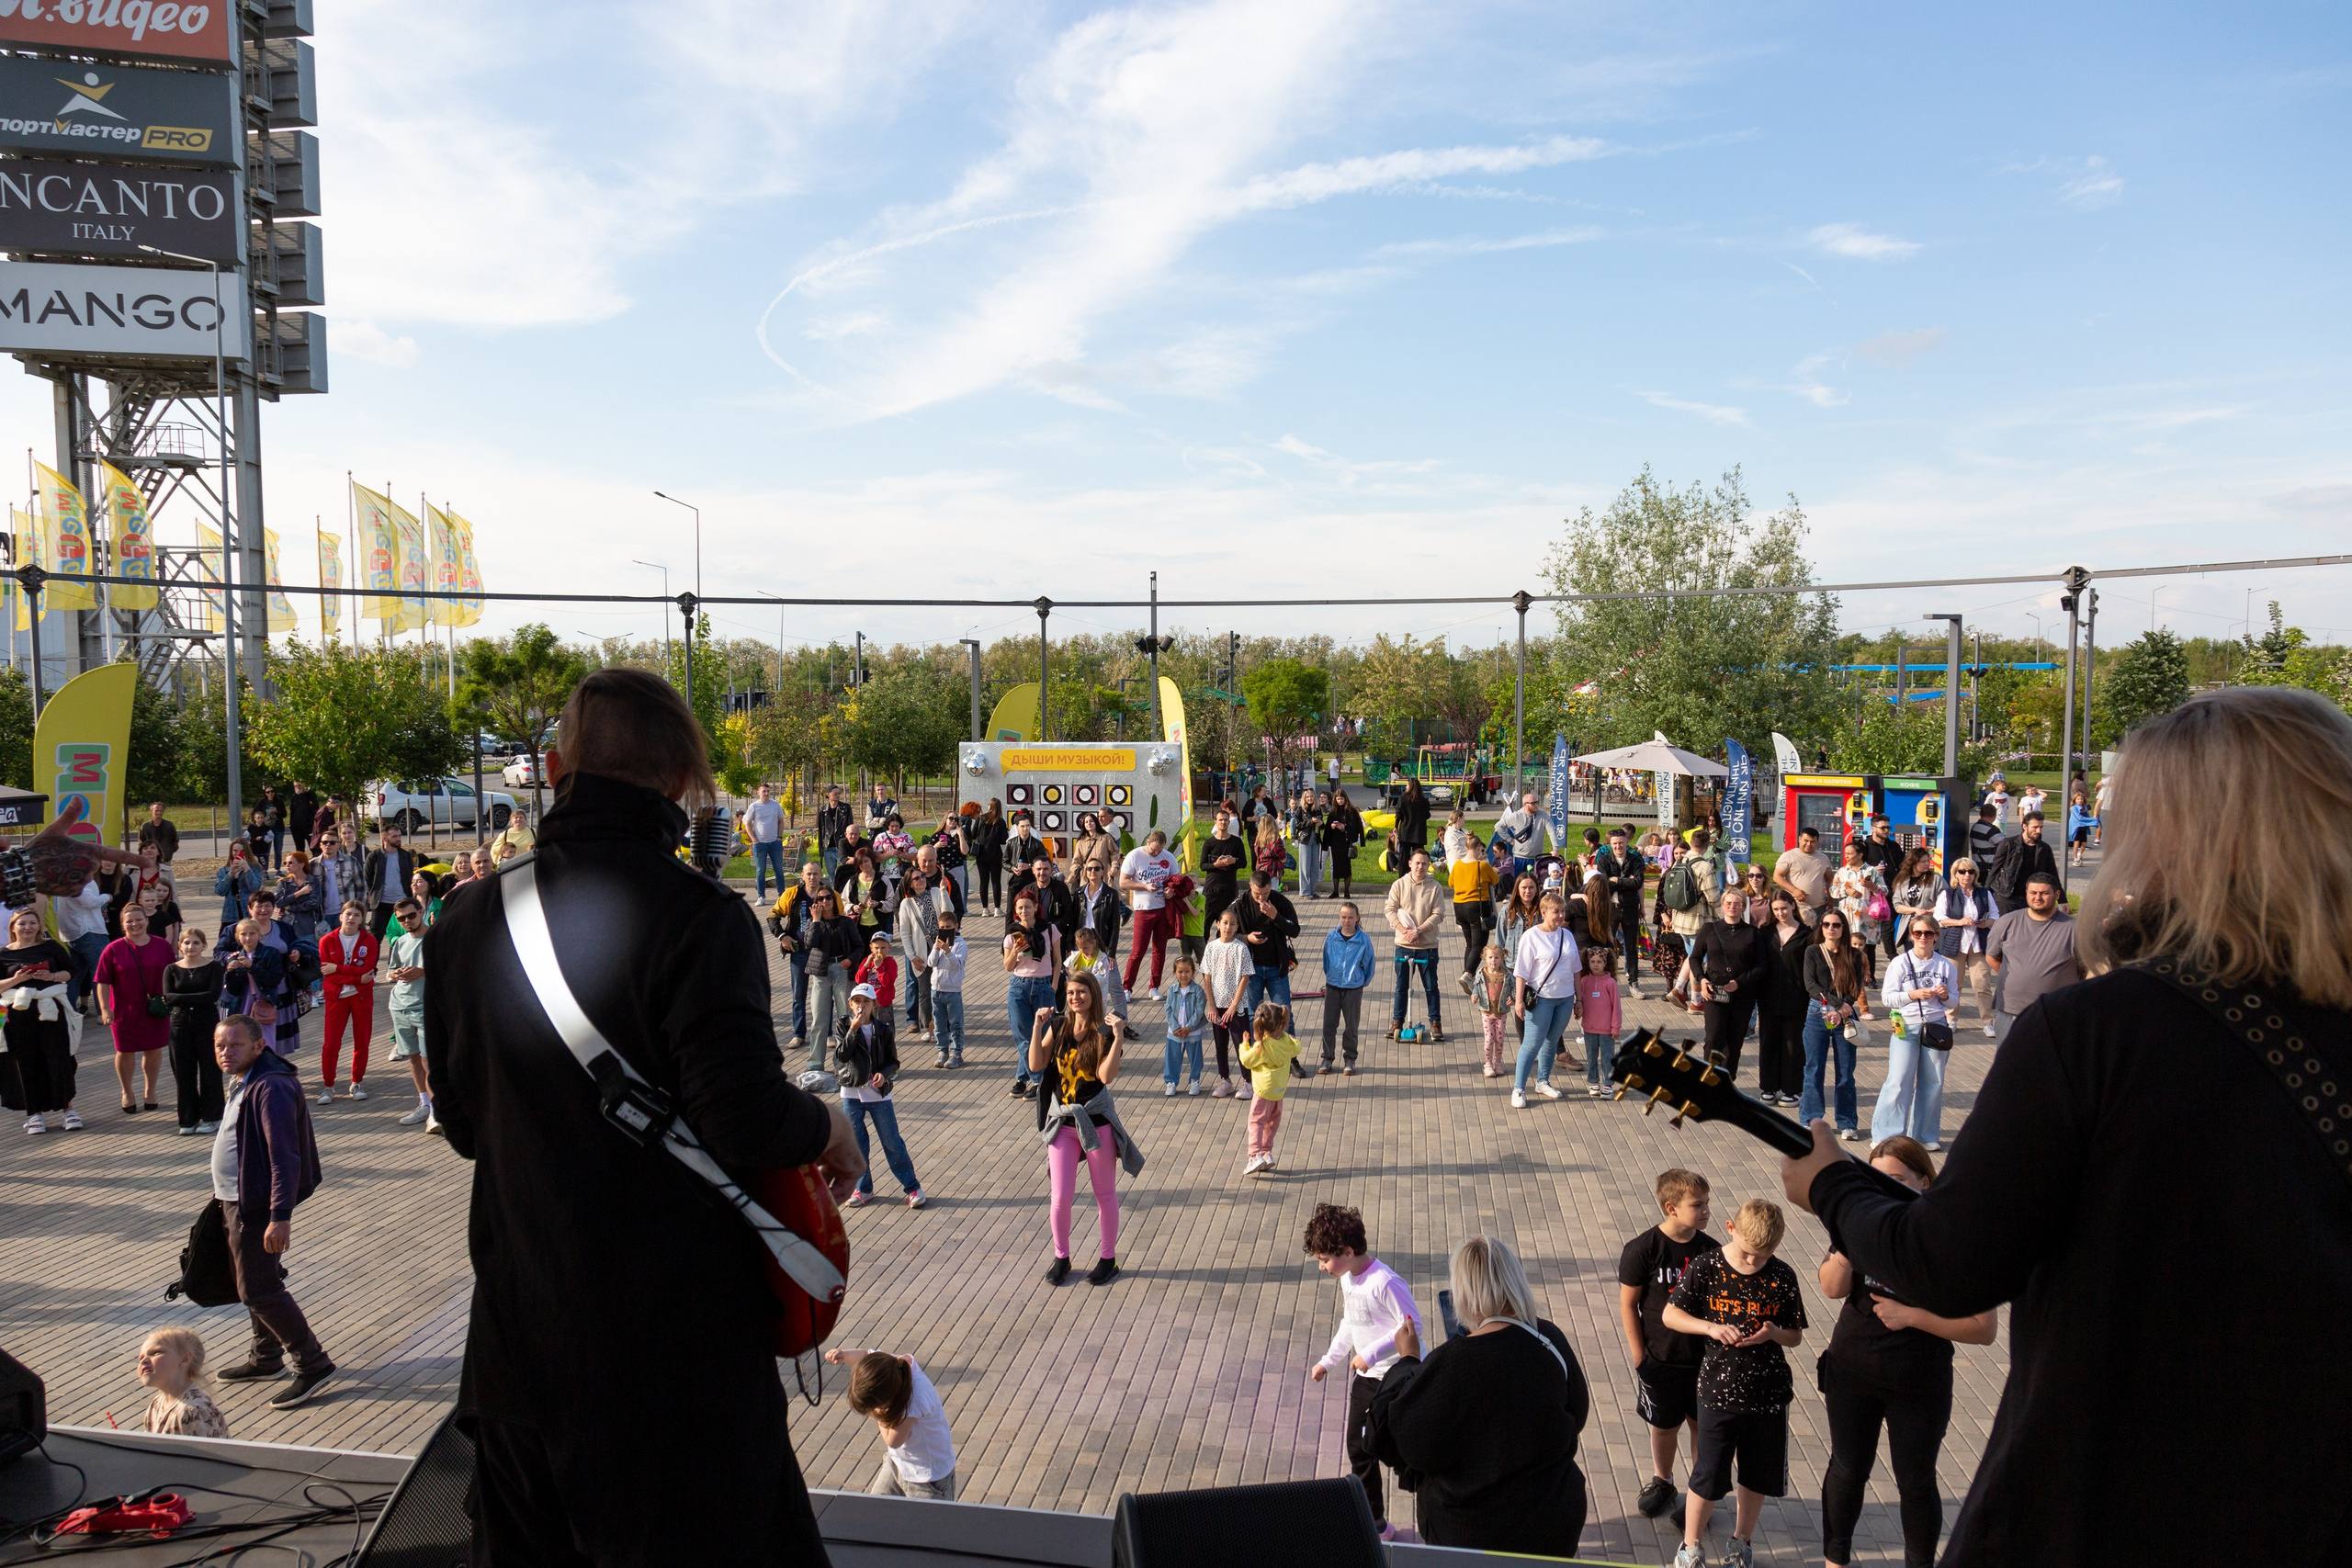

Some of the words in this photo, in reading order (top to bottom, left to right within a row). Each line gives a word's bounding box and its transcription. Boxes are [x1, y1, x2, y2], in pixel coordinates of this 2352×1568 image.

[147, 130, 207, 148] PRO
[72, 222, 137, 242] ITALY
[0, 288, 226, 332] MANGO
[1011, 755, 1054, 766] ДЫШИ
[1057, 753, 1125, 765] МУЗЫКОЙ!
[1747, 1302, 1781, 1315] PLAY
